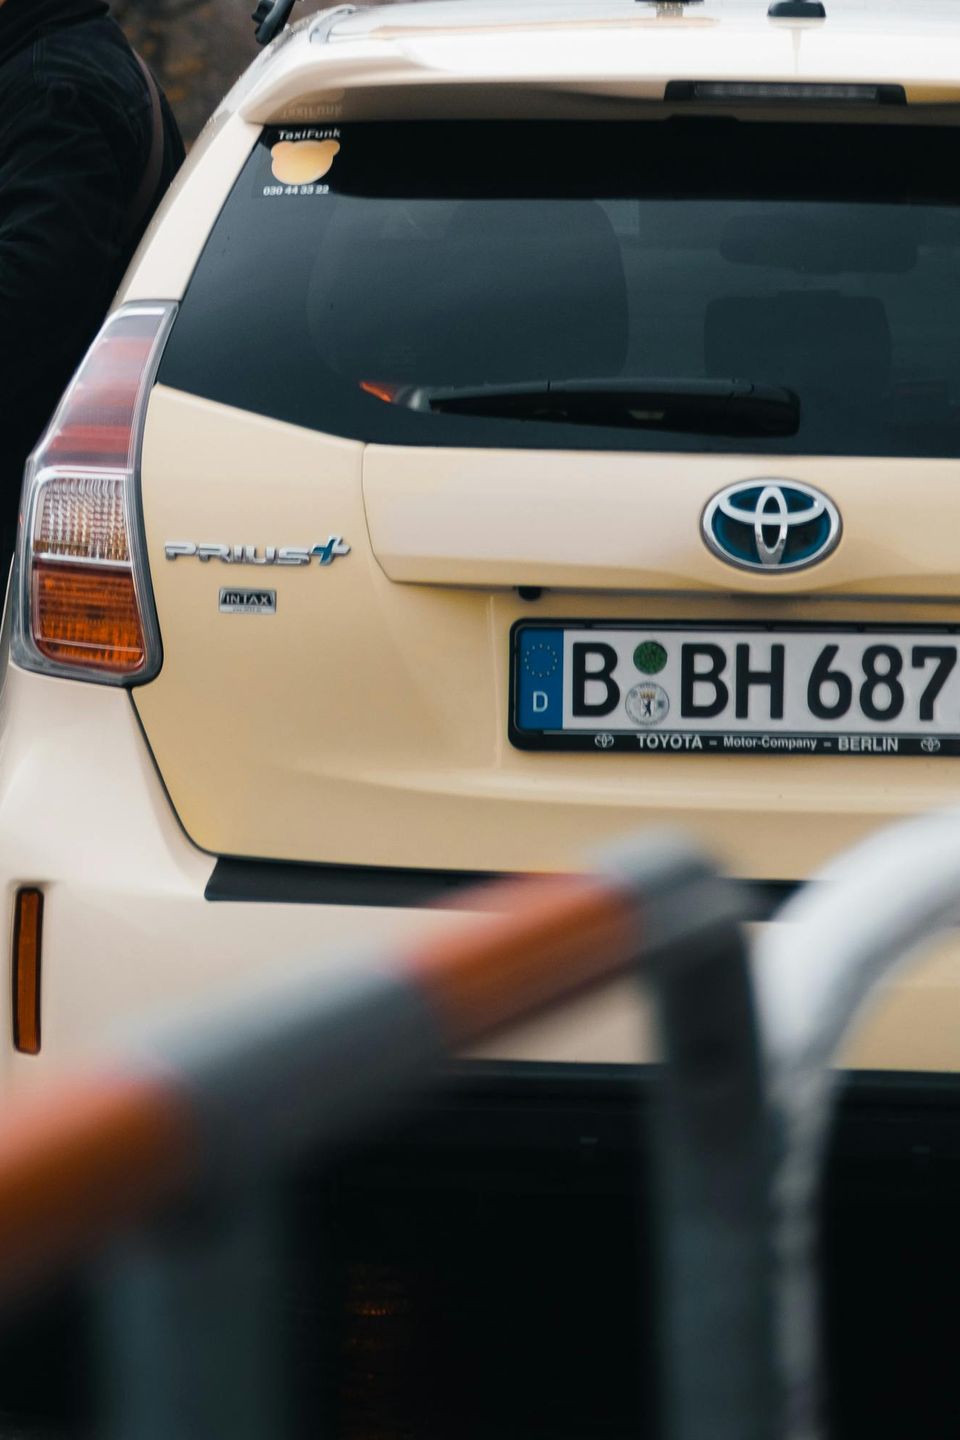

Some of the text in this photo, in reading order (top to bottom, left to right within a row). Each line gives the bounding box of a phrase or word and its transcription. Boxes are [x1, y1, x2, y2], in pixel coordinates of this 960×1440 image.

[279, 128, 340, 140] TaxiFunk
[263, 185, 283, 196] 030
[226, 593, 269, 606] INTAX
[572, 642, 620, 717] B
[681, 643, 785, 719] BH
[807, 644, 957, 721] 687
[533, 691, 548, 712] D
[637, 734, 703, 750] TOYOTA
[723, 735, 817, 751] Motor-Company
[838, 736, 899, 752] BERLIN
